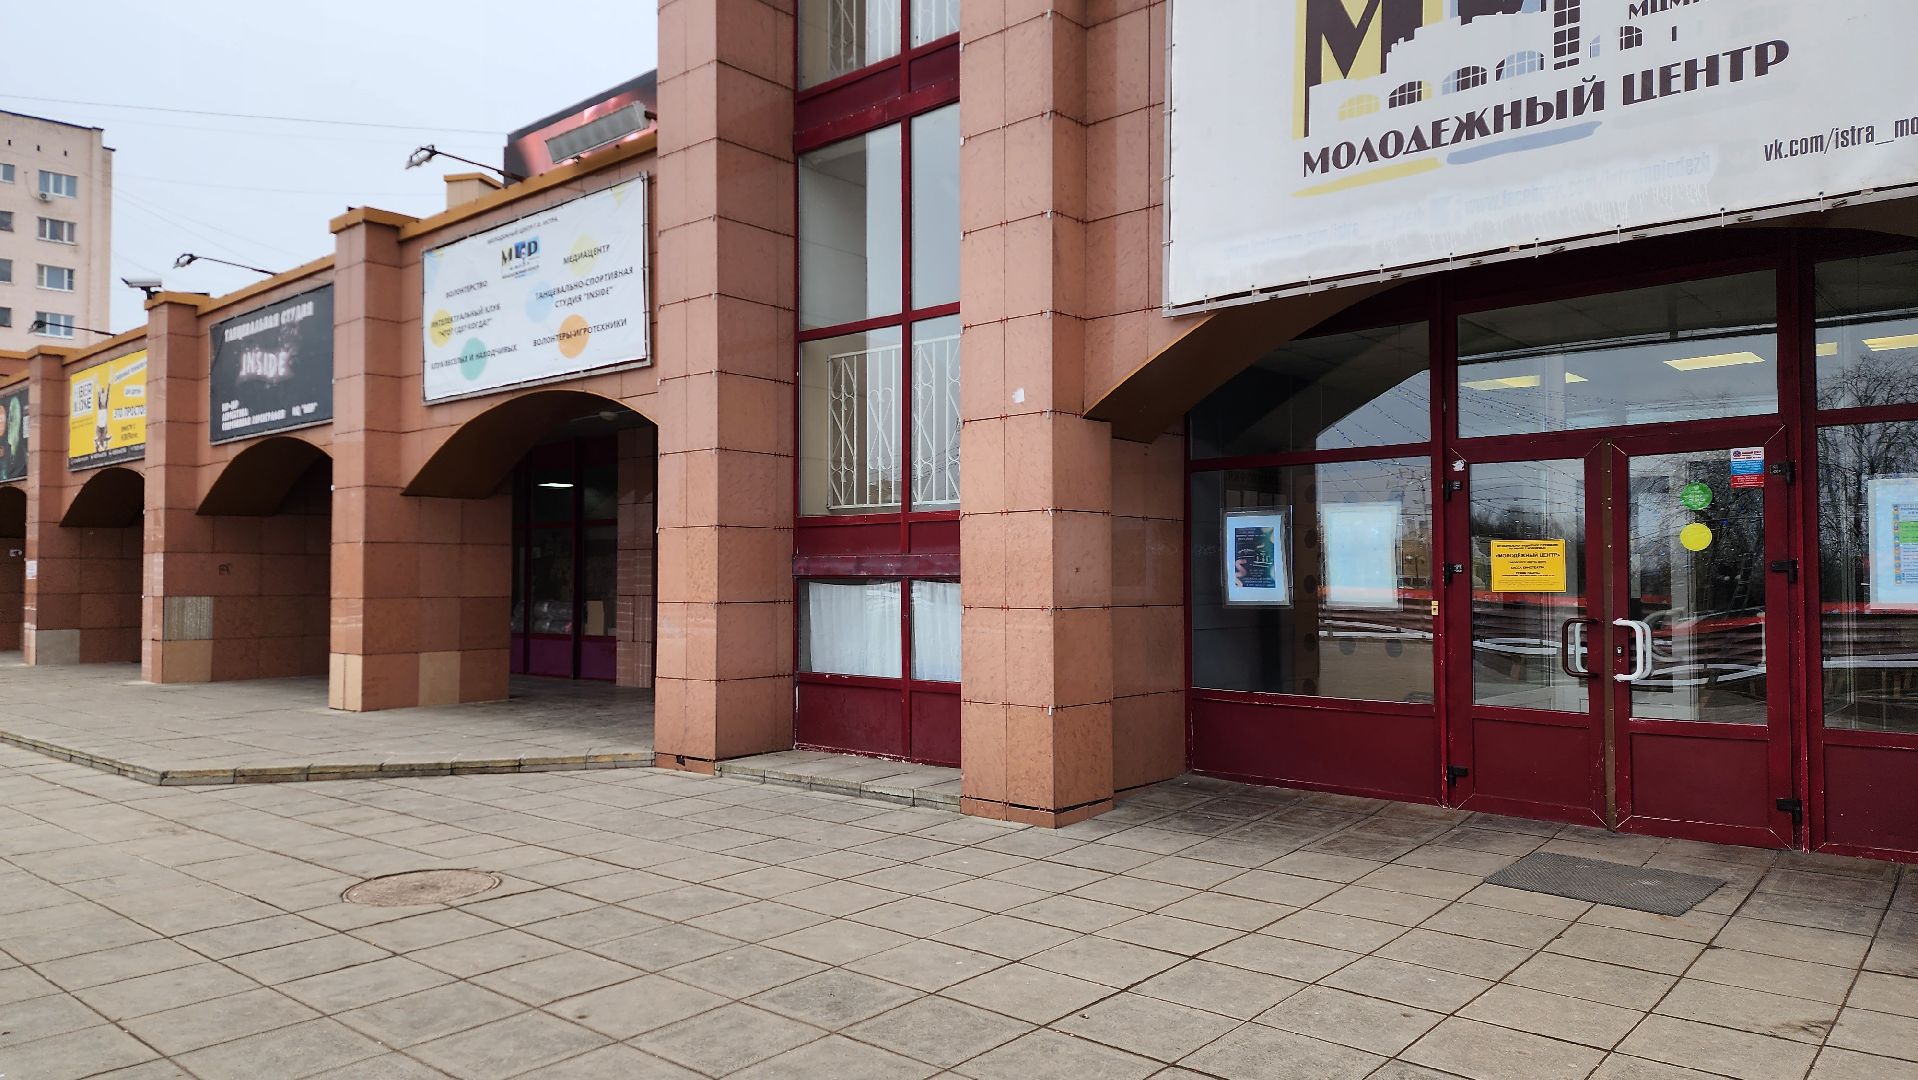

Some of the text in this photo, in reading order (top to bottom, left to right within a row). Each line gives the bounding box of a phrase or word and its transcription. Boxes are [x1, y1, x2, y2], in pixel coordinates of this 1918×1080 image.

[1303, 39, 1790, 178] МОЛОДЕЖНЫЙ ЦЕНТР
[563, 244, 610, 264] МЕДИАЦЕНТР
[535, 266, 633, 300] ТАНЦЕВАЛЬНО-СПОРТИВНАЯ
[554, 294, 582, 308] СТУДИЯ
[533, 317, 627, 347] ВОЛОНТЕРЫ-ИГРОТЕХНИКИ
[240, 350, 287, 377] INSIDE
